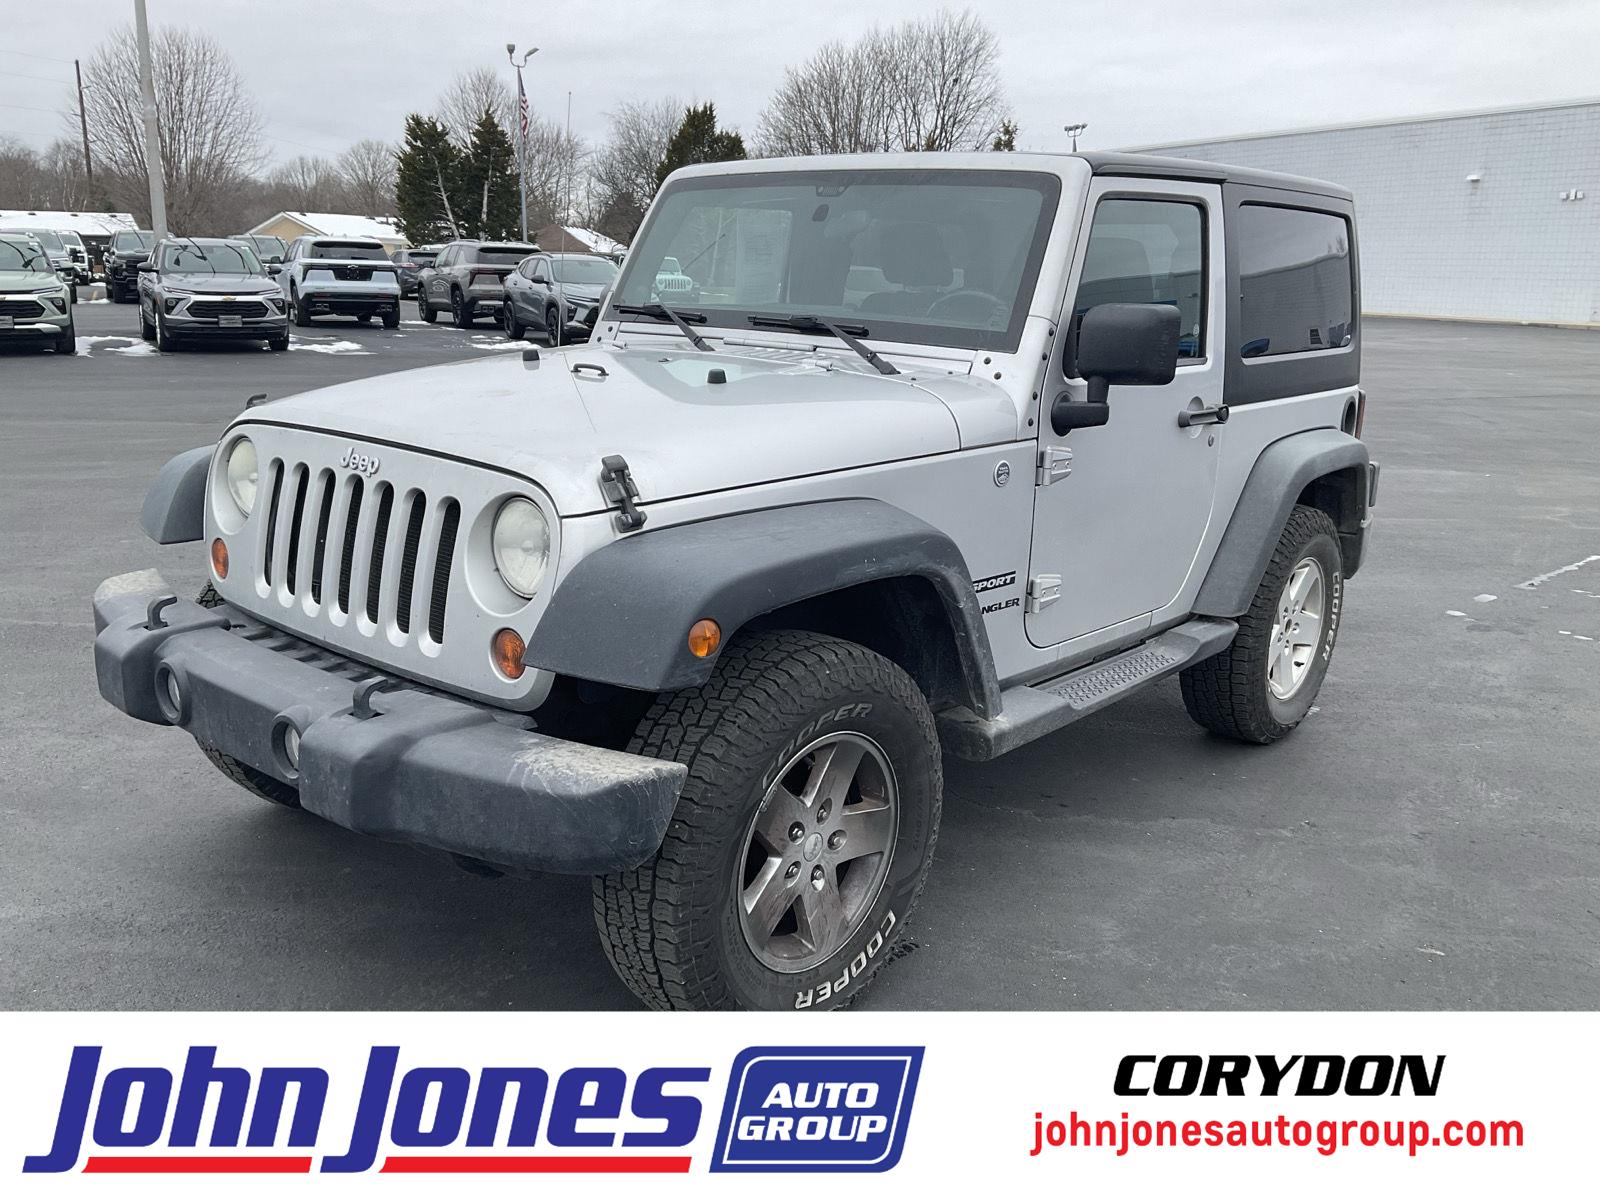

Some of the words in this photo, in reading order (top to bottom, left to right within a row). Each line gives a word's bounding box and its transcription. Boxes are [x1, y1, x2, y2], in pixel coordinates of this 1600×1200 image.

[340, 447, 380, 477] Jeep
[981, 598, 1020, 615] NGLER
[762, 703, 873, 789] COOPER
[795, 909, 896, 1010] COOPER
